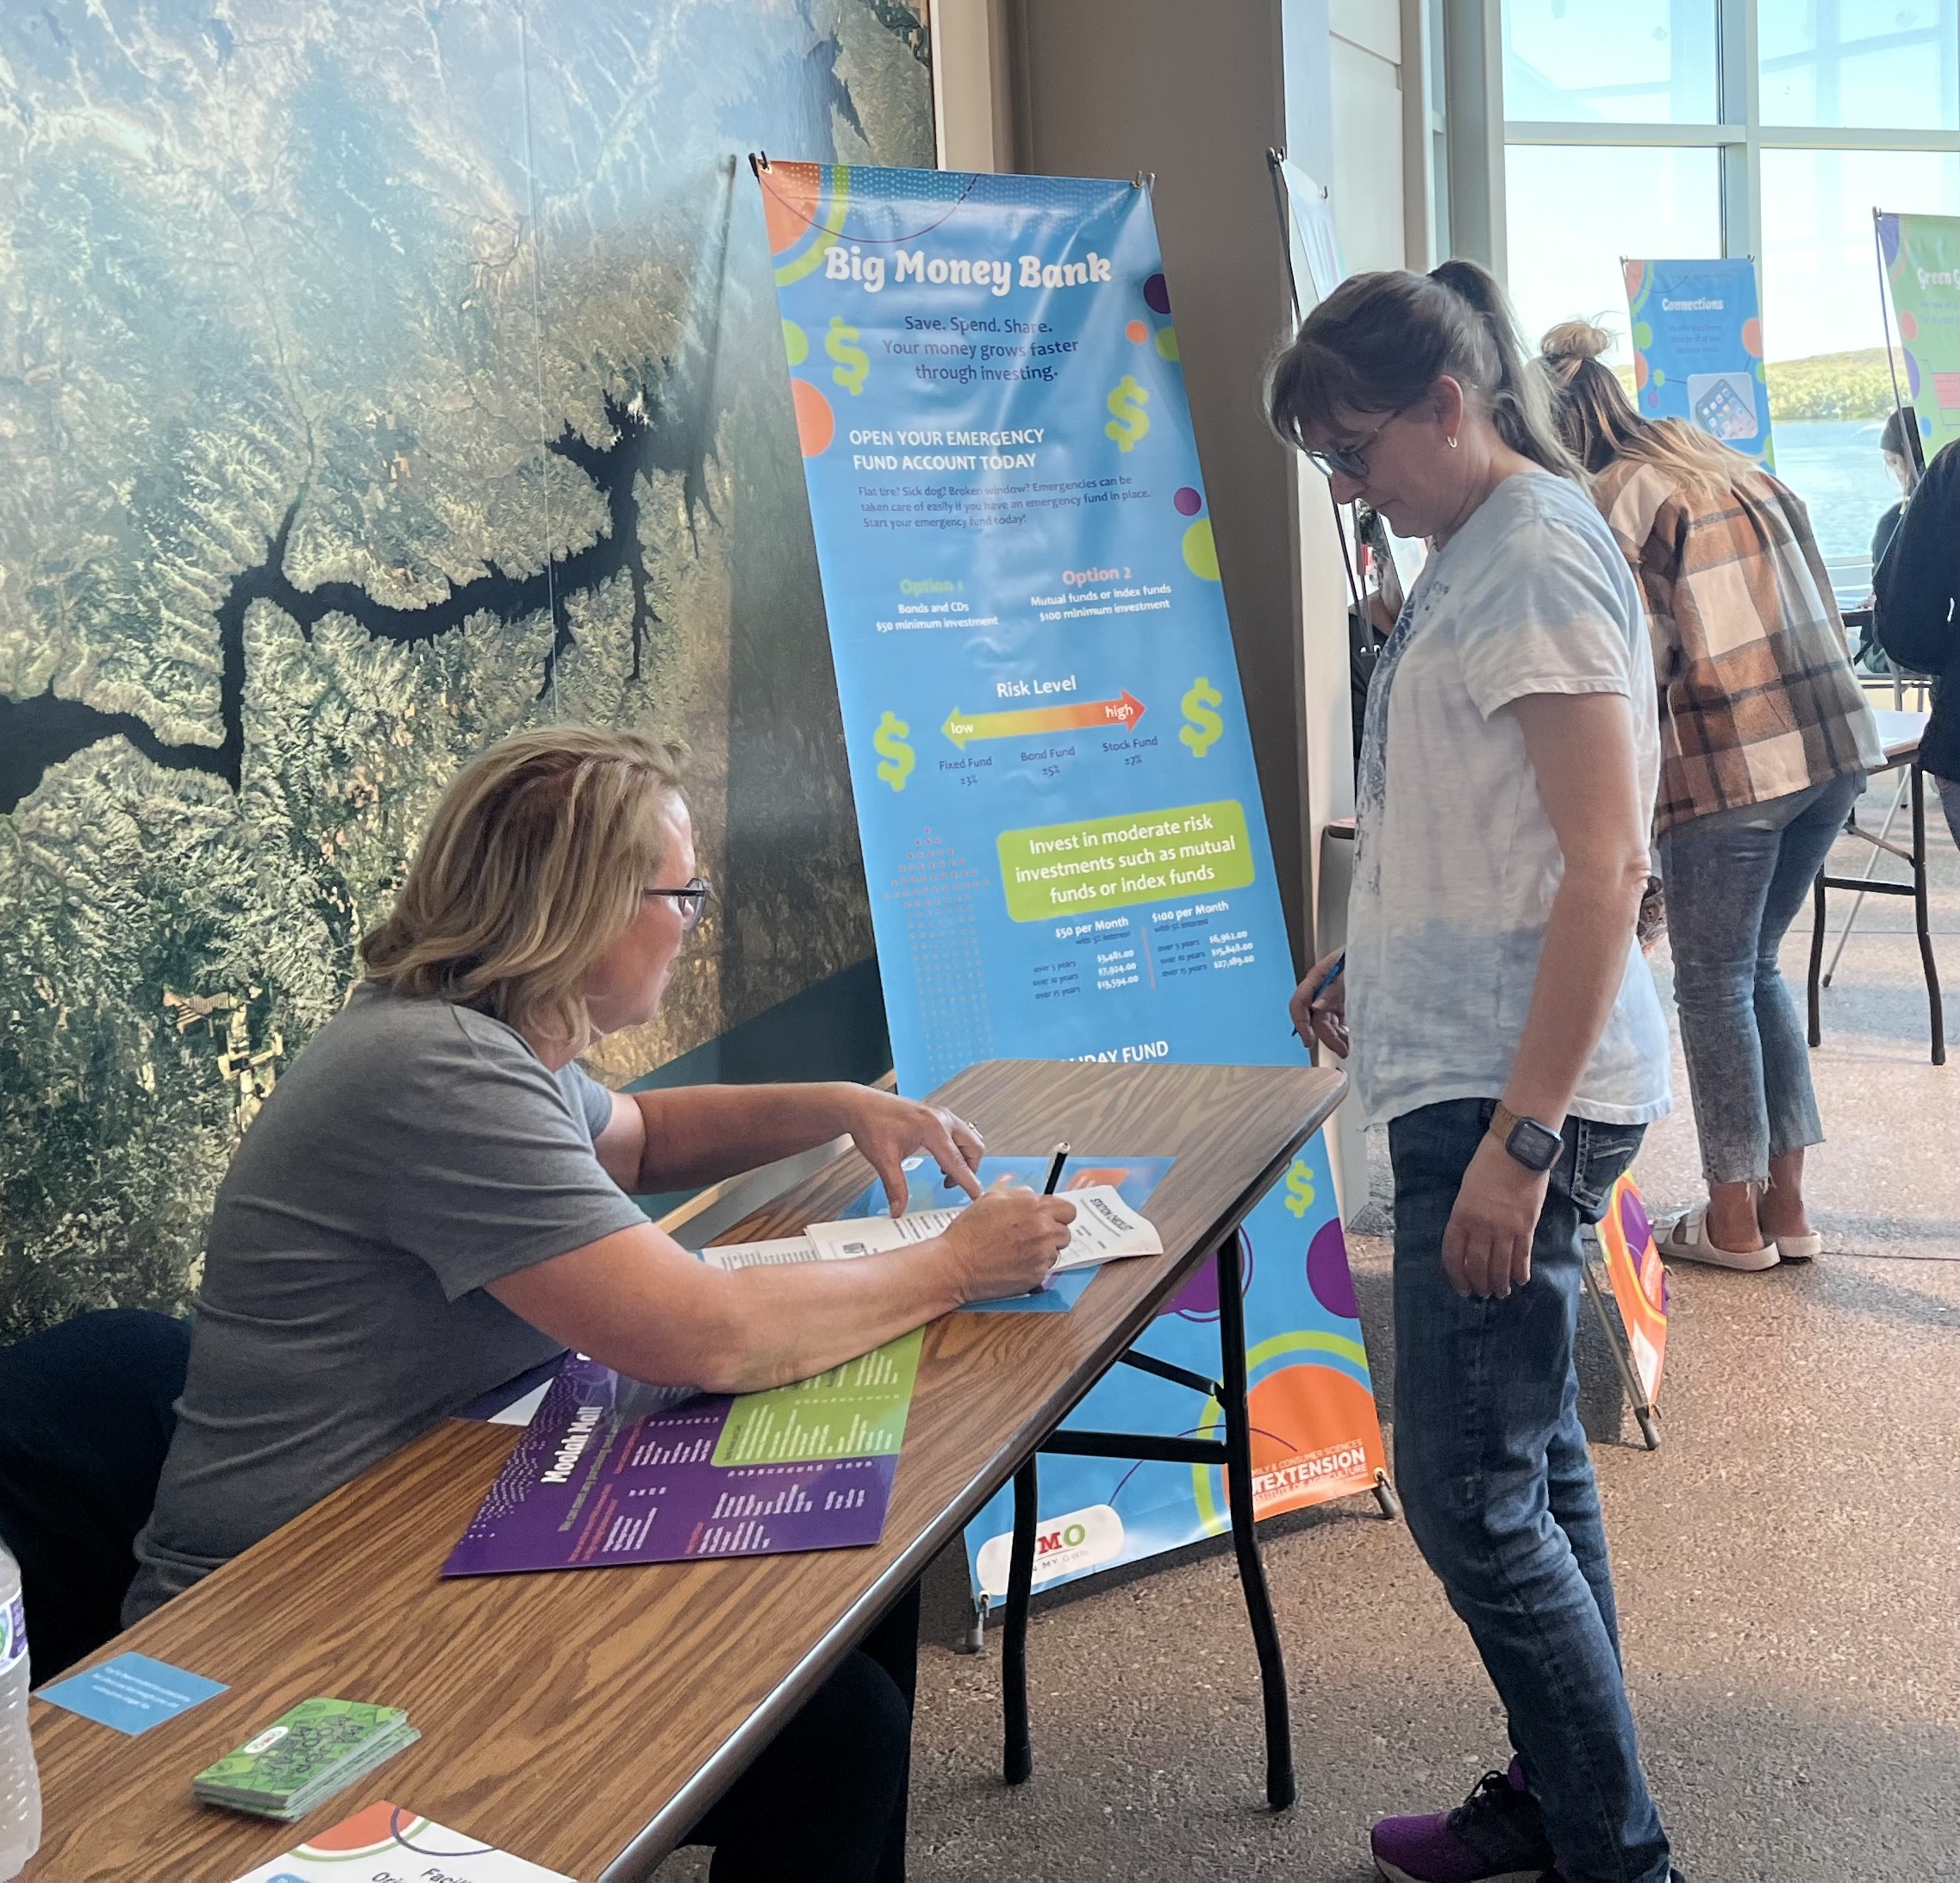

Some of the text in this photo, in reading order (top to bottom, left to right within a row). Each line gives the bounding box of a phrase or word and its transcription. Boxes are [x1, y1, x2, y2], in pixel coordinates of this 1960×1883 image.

[824, 245, 1112, 296] Big Money Bank
[1662, 297, 1724, 311] Connections
[905, 315, 1053, 335] Save. Spend. Share.
[883, 340, 1079, 360] Your money grows faster
[915, 364, 1058, 384] through investing.
[849, 428, 1045, 446] OPEN YOUR EMERGENCY
[852, 453, 1036, 471] FUND ACCOUNT TODAY
[858, 476, 1133, 499] Flat tire? Sick dog? Broken window? Emergencies can be
[861, 489, 1151, 514] taken care of easily if you have an emergency fund in place.
[863, 514, 1027, 530] Start your emergency fund today!
[899, 578, 953, 596] Option
[1063, 567, 1133, 588] Option 2
[1031, 594, 1066, 606] Mutual
[1068, 590, 1098, 602] funds
[1113, 587, 1140, 598] index
[1143, 583, 1172, 595] funds
[897, 602, 970, 614] Bonds and CDs
[1039, 600, 1170, 622] $100 minimum investment
[876, 616, 1000, 633] $50 minimum investment
[996, 675, 1077, 698] Risk Level
[1105, 703, 1133, 720] high
[950, 722, 974, 734] low
[1021, 746, 1076, 762] Bond Fund
[1102, 736, 1158, 752] Stock Fund
[939, 757, 993, 770] Fixed Fund
[1029, 814, 1214, 855] Invest in moderate risk
[1015, 835, 1236, 883] investments such as mutual
[1050, 864, 1215, 904] funds or index funds
[1152, 900, 1229, 923] $100 per Month
[1055, 916, 1129, 938] $50 per Month
[1122, 1040, 1169, 1063] FUND
[540, 1434, 590, 1482] Moolah
[566, 1406, 603, 1432] Mall
[1037, 1524, 1086, 1555] MO
